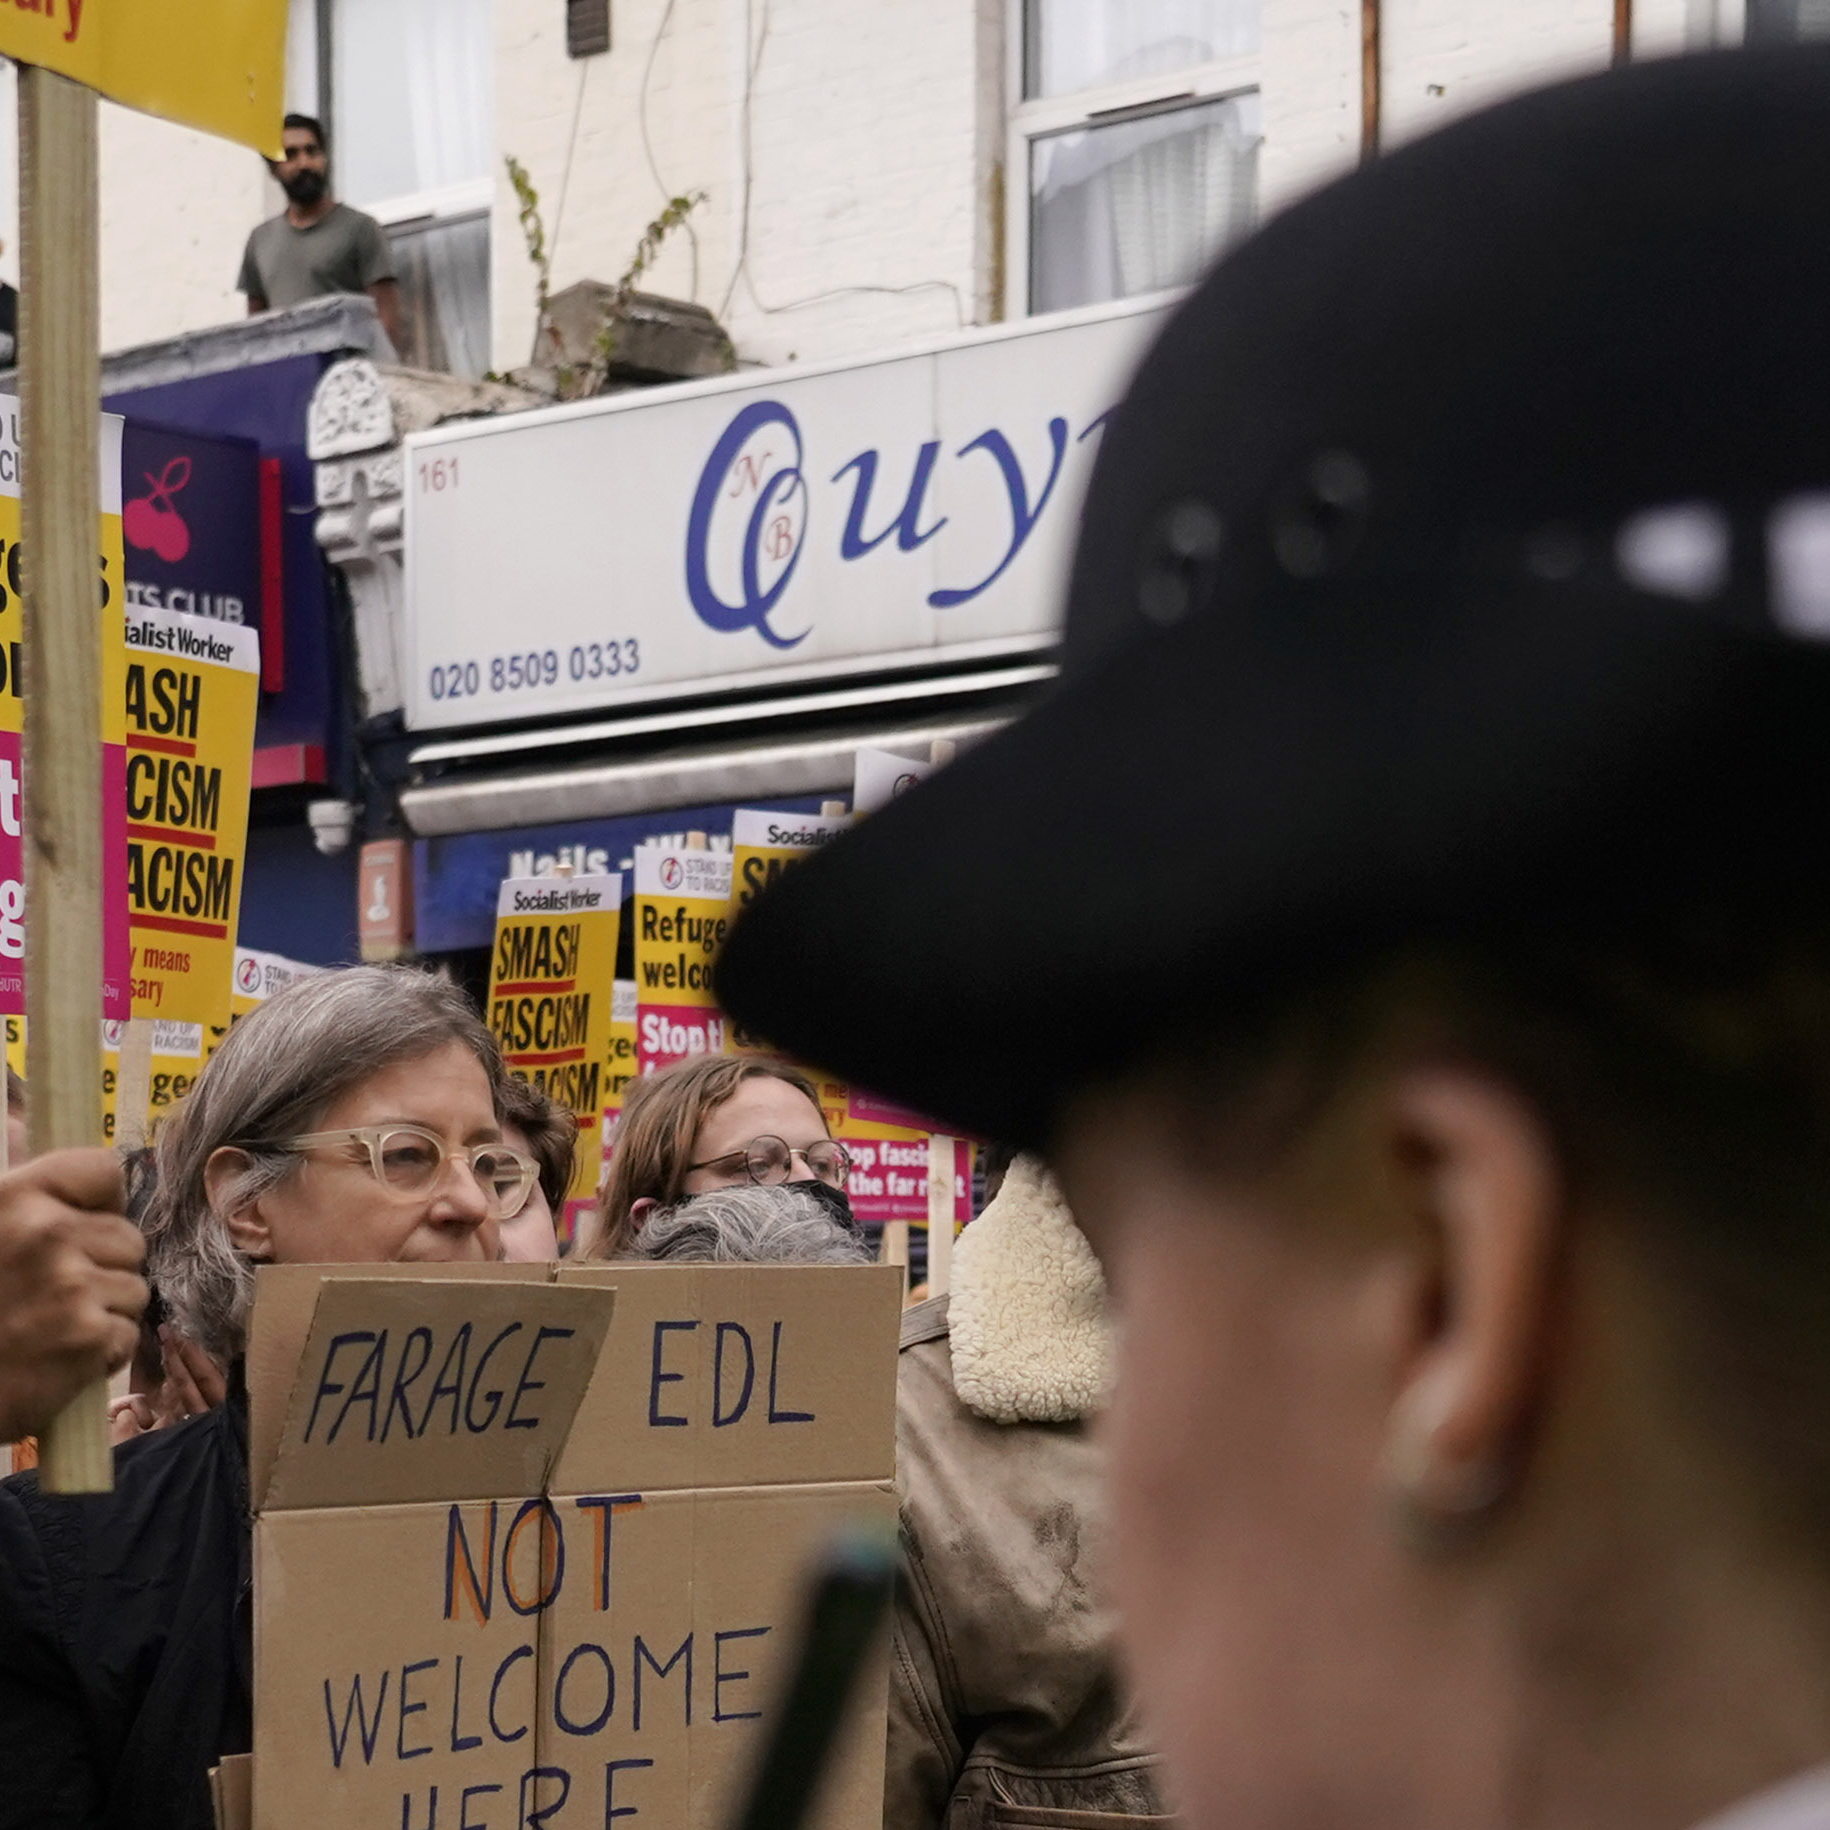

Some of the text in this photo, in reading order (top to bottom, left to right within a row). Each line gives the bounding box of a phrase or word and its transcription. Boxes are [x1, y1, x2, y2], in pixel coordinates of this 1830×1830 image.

[419, 457, 459, 493] 161
[686, 399, 1115, 650] Quy
[177, 625, 235, 664] Worker
[430, 637, 641, 701] 020 8509 0333
[125, 663, 201, 739] ASH
[127, 754, 222, 832] CISM
[127, 843, 235, 921] ACISM
[514, 888, 602, 911] Socialist Worker
[143, 947, 191, 973] means
[497, 923, 581, 982] SMASH
[493, 993, 590, 1050] FASCISM
[642, 1013, 706, 1055] Stop
[848, 1172, 884, 1196] the
[886, 1171, 917, 1196] far
[303, 1320, 816, 1446] FARAGE EDL
[444, 1494, 643, 1627] NOT
[324, 1626, 773, 1769] WELCOME
